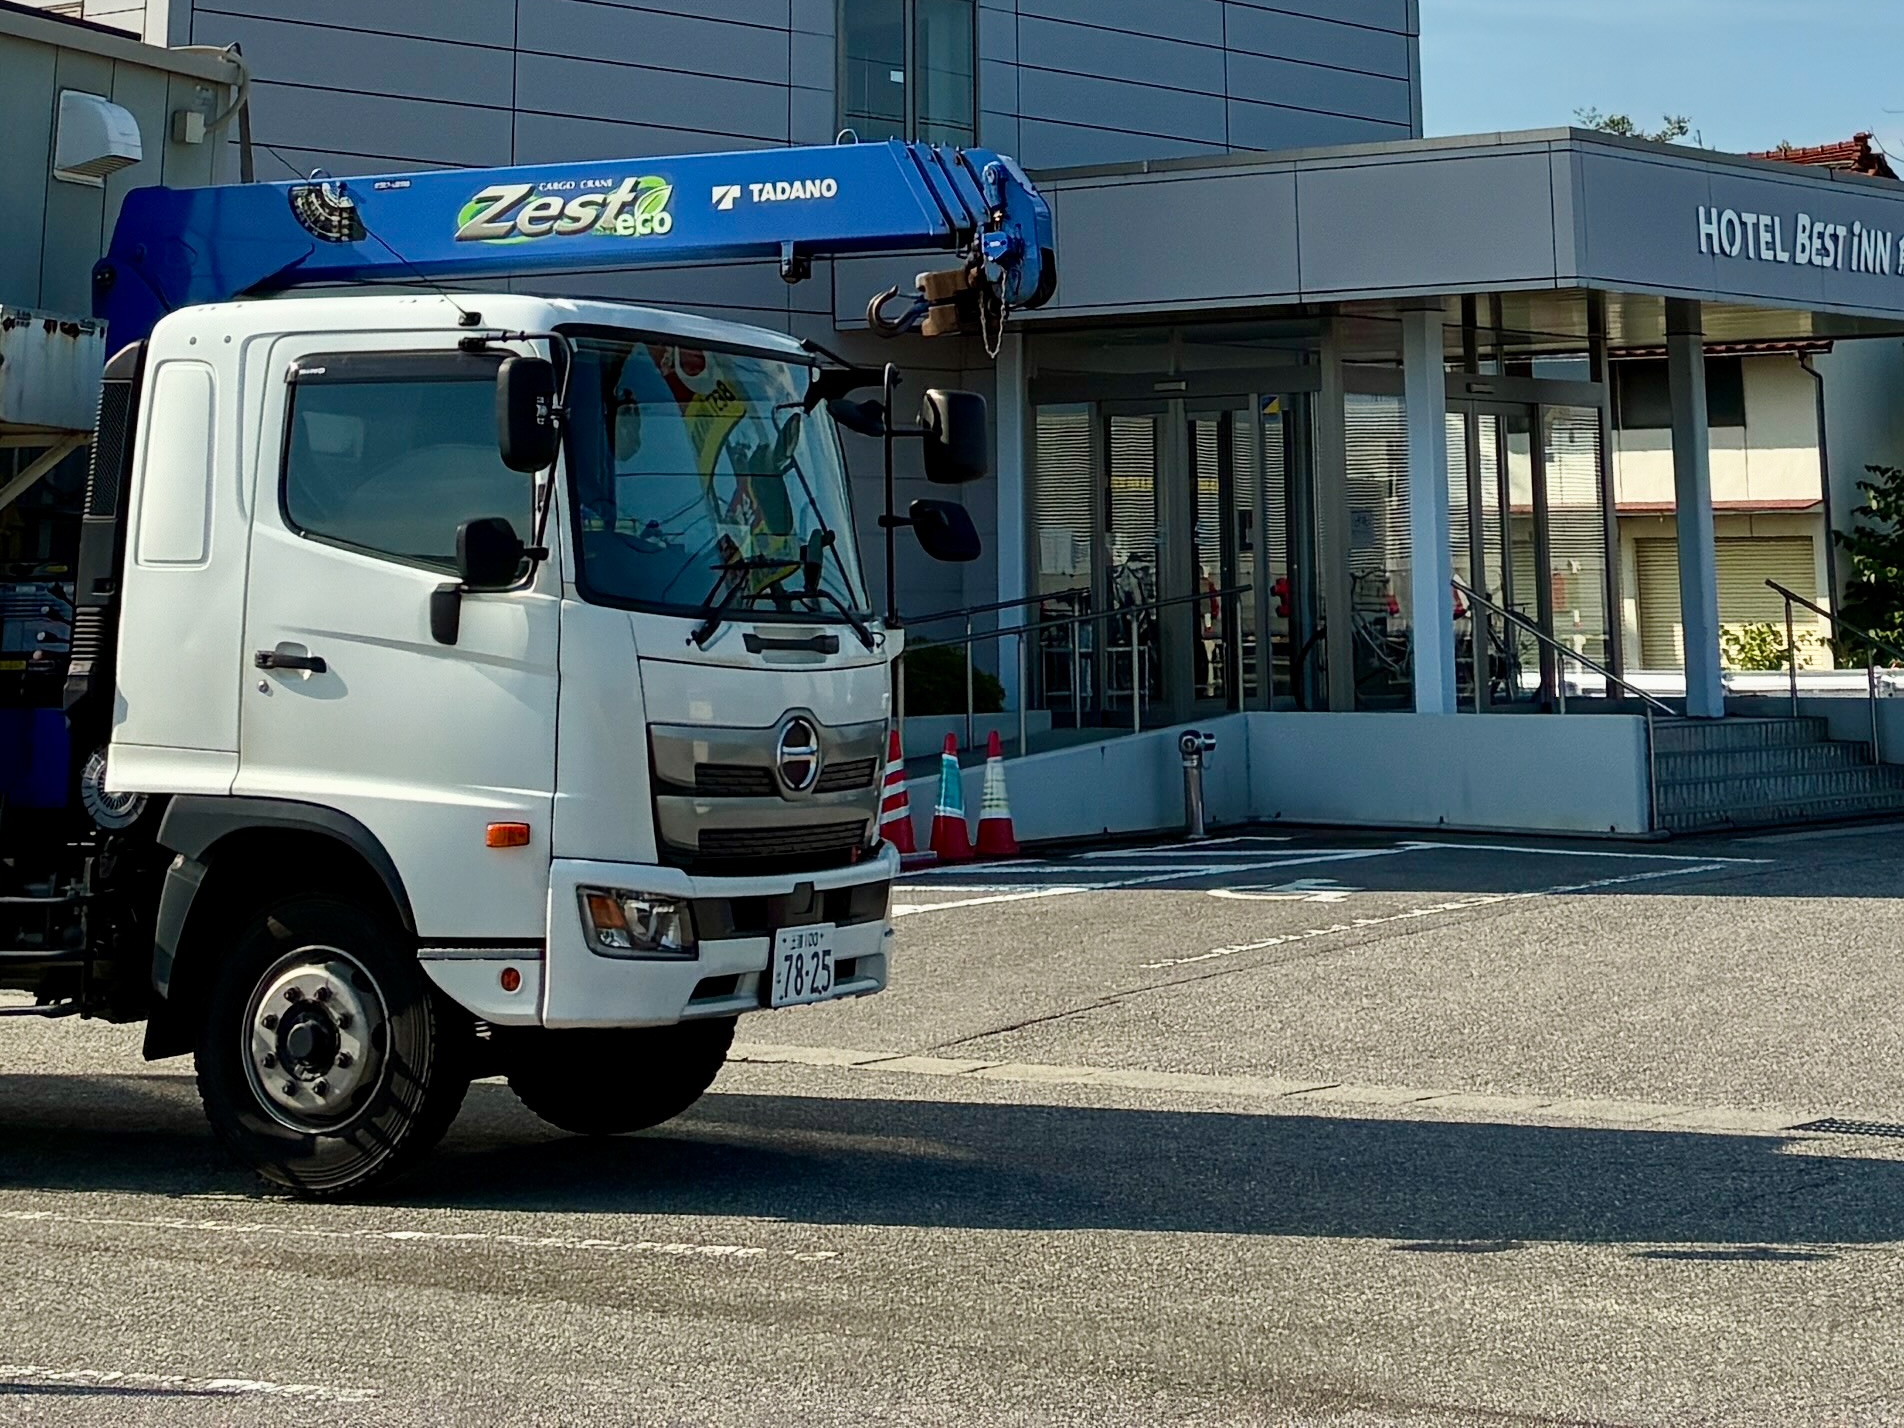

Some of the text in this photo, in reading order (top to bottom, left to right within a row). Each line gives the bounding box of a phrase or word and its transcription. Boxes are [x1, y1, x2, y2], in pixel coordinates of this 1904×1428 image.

[539, 181, 576, 191] CARGO
[749, 178, 838, 203] TADANO
[455, 177, 639, 241] Zest
[616, 211, 673, 236] eco
[1698, 206, 1789, 263] HOTEL
[1796, 213, 1847, 271] BEST
